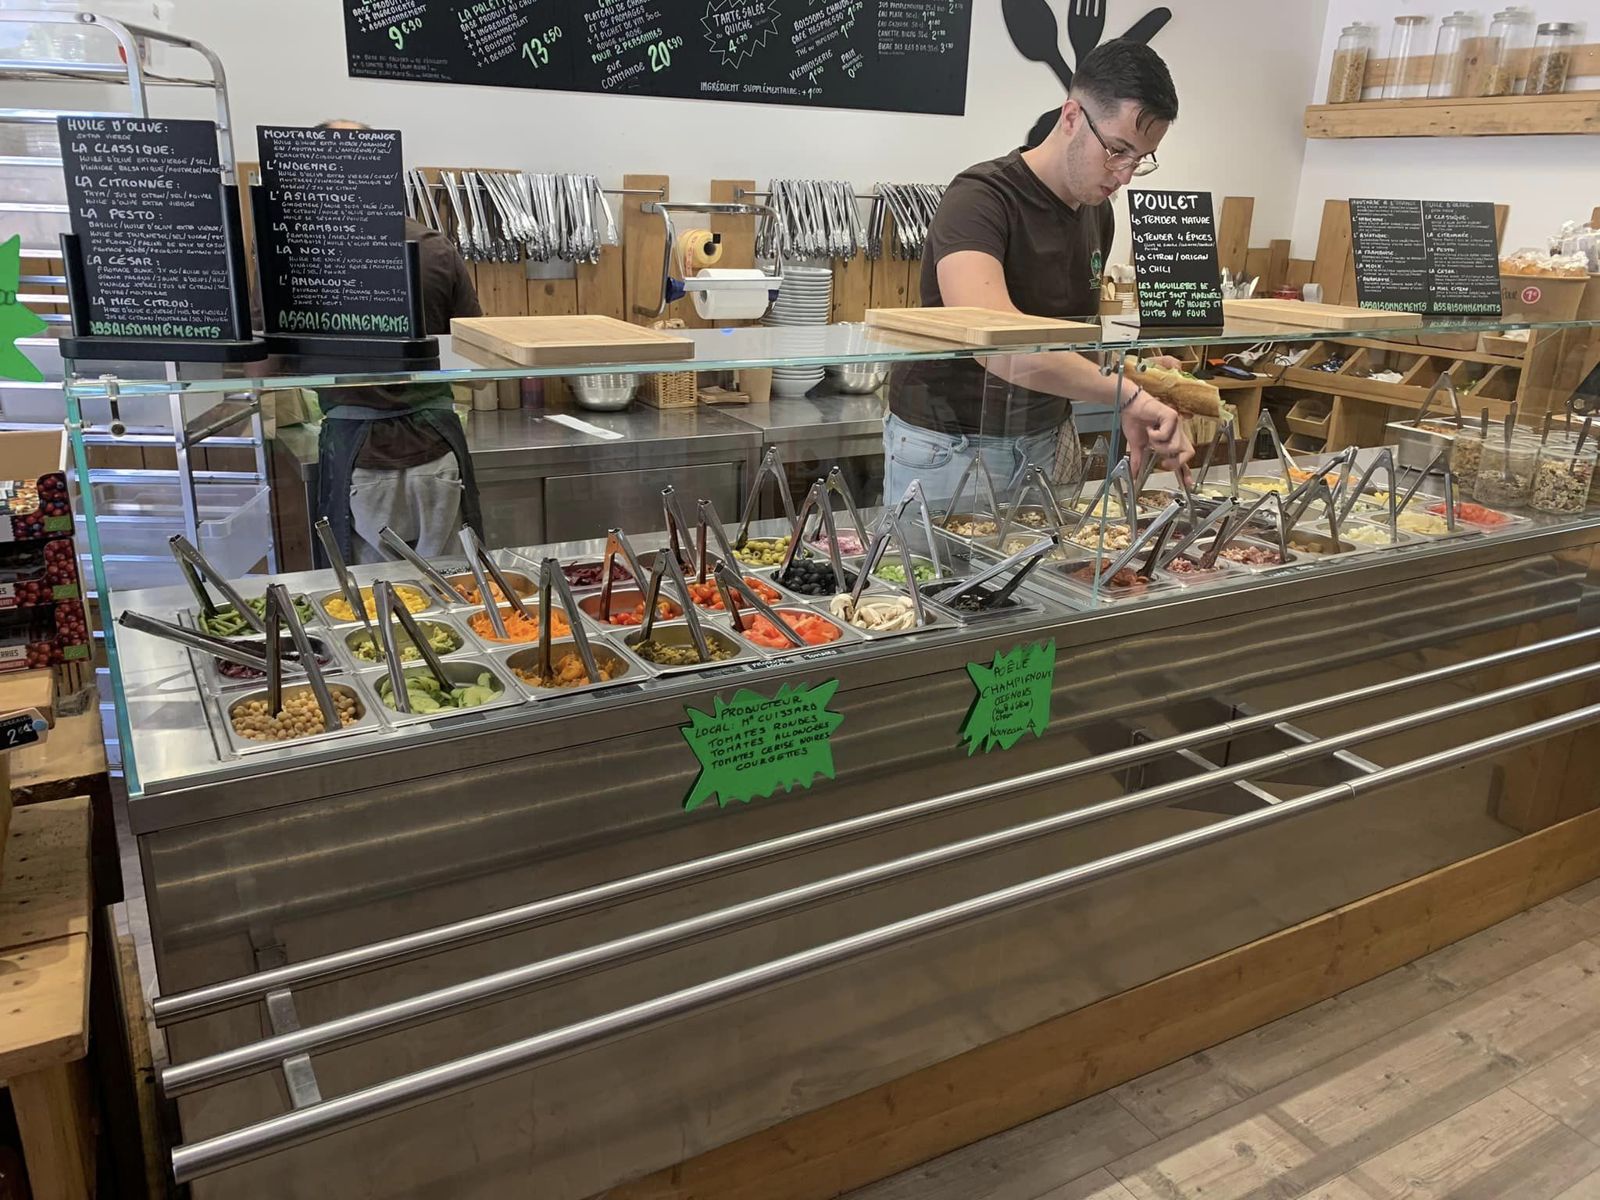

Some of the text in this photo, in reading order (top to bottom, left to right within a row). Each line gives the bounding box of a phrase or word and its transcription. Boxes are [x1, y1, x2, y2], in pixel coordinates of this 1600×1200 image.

[713, 10, 742, 26] TARTE
[794, 10, 825, 31] BOISSONS
[725, 20, 752, 36] QUICHE
[841, 48, 856, 63] PAIN
[789, 50, 833, 80] VIENNOISERIE
[602, 62, 645, 90] COMMANDE
[68, 119, 106, 132] HUILE
[264, 130, 326, 140] MOUTARDE
[72, 142, 87, 153] LA
[75, 176, 93, 188] LA
[1134, 192, 1198, 210] POULET
[80, 208, 97, 218] LA
[1142, 215, 1210, 225] TENDER NATURE
[273, 222, 288, 231] LA
[1144, 233, 1174, 241] TENDER
[1186, 232, 1213, 241] ÉPICES
[276, 245, 292, 254] LA
[1149, 265, 1170, 273] CHILI
[92, 297, 105, 305] LA
[111, 298, 140, 306] MIEL
[1140, 300, 1169, 308] DURANT
[1175, 299, 1185, 307] 15
[1434, 302, 1501, 312] ASSAISONNEMENTS
[279, 310, 408, 332] ASSAISONNEMENTS
[721, 696, 802, 720] PRODUCTEUR
[758, 703, 817, 722] CUISSARD
[708, 715, 818, 748] TOMATES RONDES
[711, 737, 764, 758] TOMATES
[712, 732, 830, 769] TOMATES CERISE NOIRES
[736, 747, 808, 772] COURGETTES
